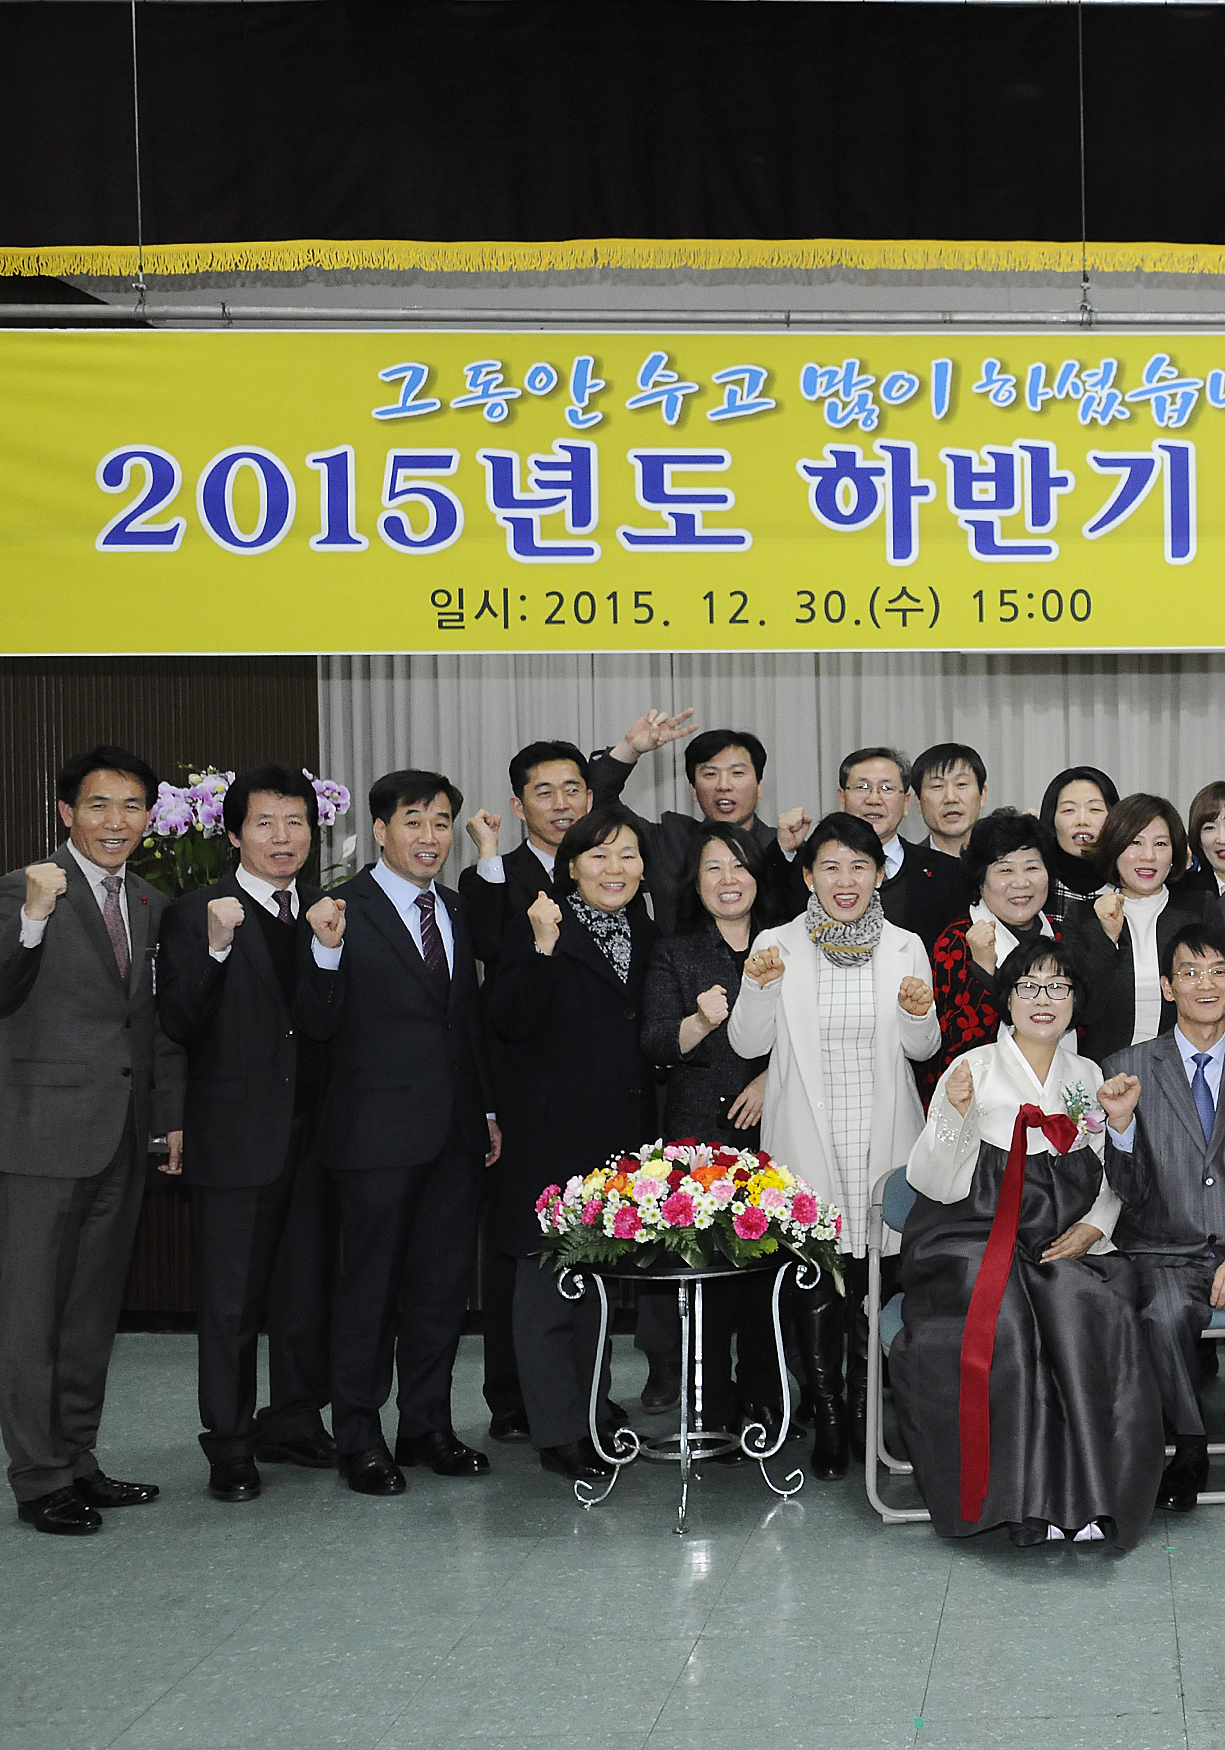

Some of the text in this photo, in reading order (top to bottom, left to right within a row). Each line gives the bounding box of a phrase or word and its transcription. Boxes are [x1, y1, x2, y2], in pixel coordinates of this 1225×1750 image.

[373, 357, 602, 427] 그동안
[628, 353, 773, 423] 수고
[801, 360, 950, 429] 많이
[99, 441, 749, 560] 2015년도
[799, 441, 1194, 563] 하반기
[429, 585, 1093, 631] 일시: 2015. 12. 30.(수) 15:00
